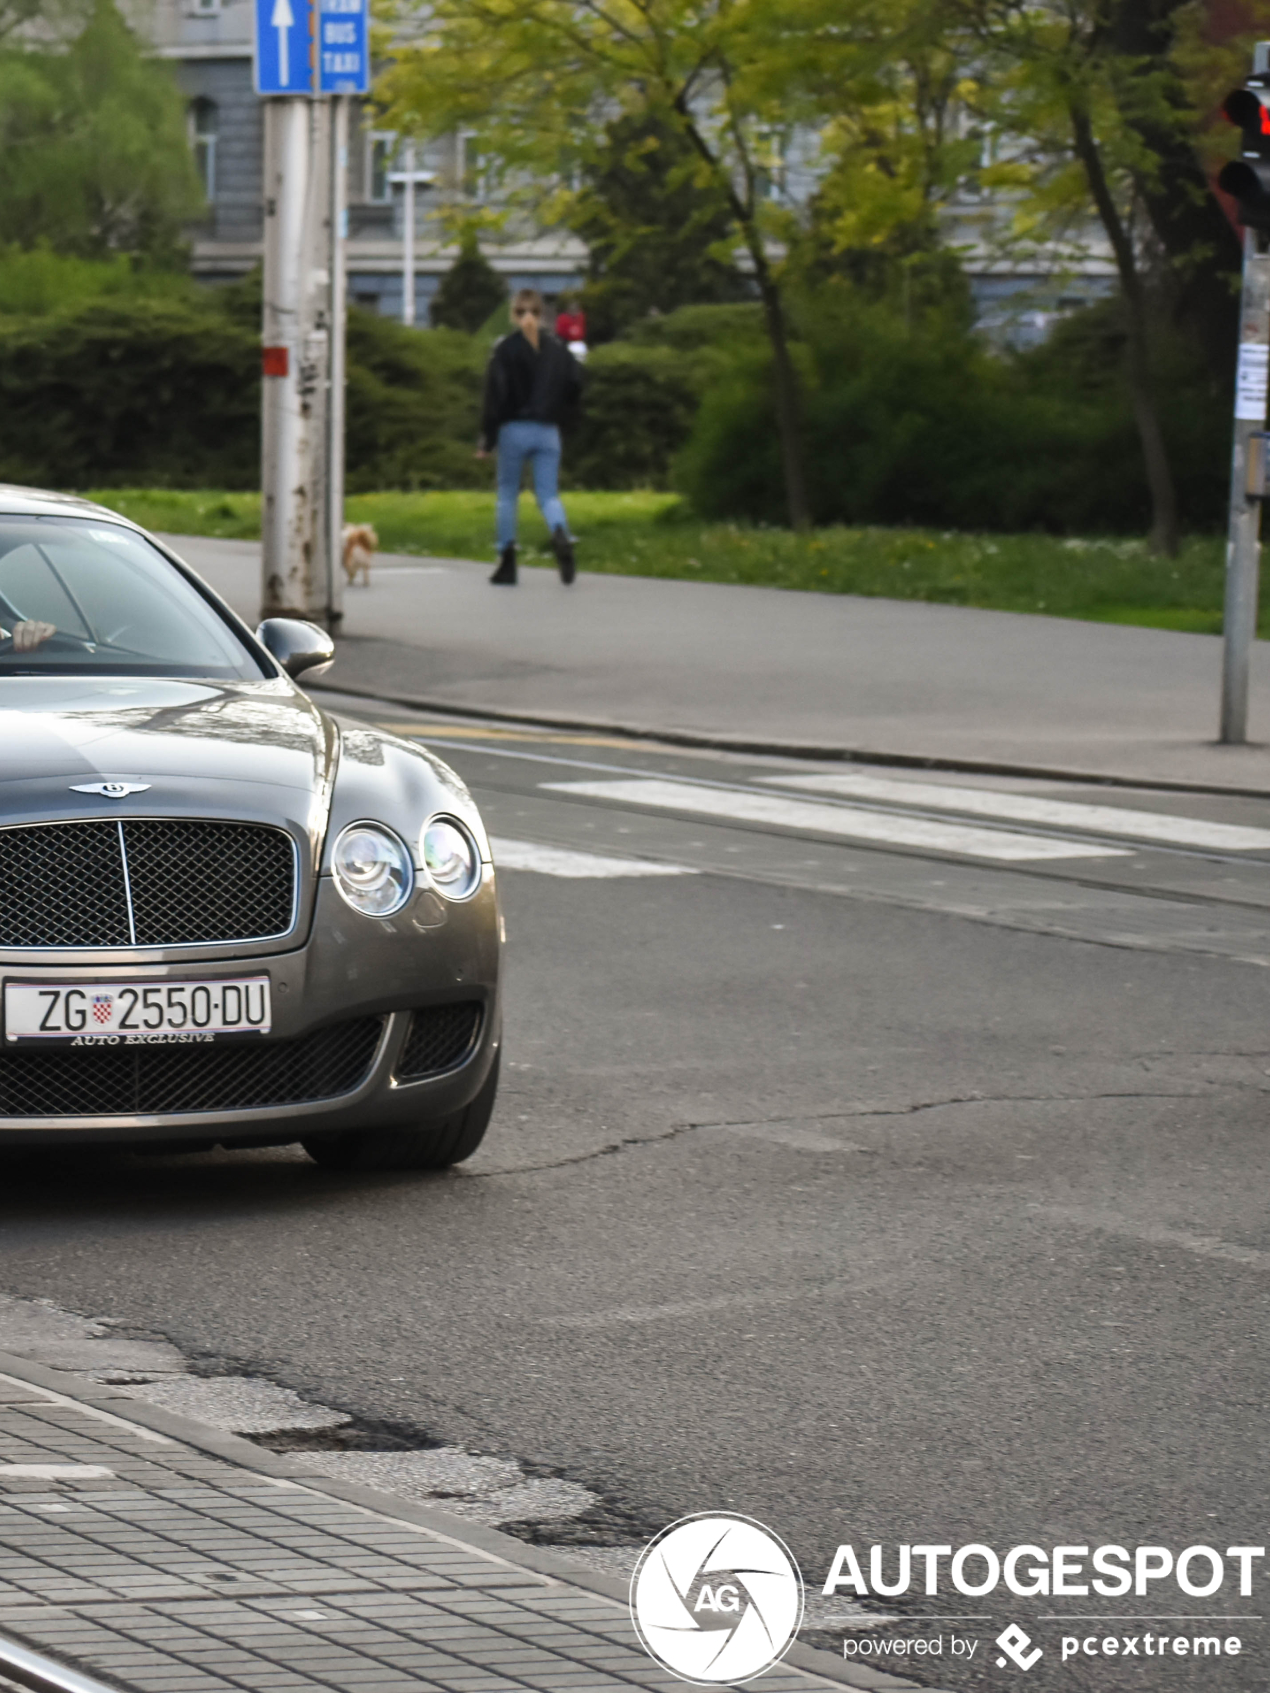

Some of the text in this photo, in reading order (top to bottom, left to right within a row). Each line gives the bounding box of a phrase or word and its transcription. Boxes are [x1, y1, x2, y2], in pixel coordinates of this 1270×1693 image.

[324, 22, 356, 44] BUS
[323, 52, 360, 73] TAXI
[38, 988, 87, 1032] ZG
[70, 1033, 215, 1046] AUTO EXCLUSIVE
